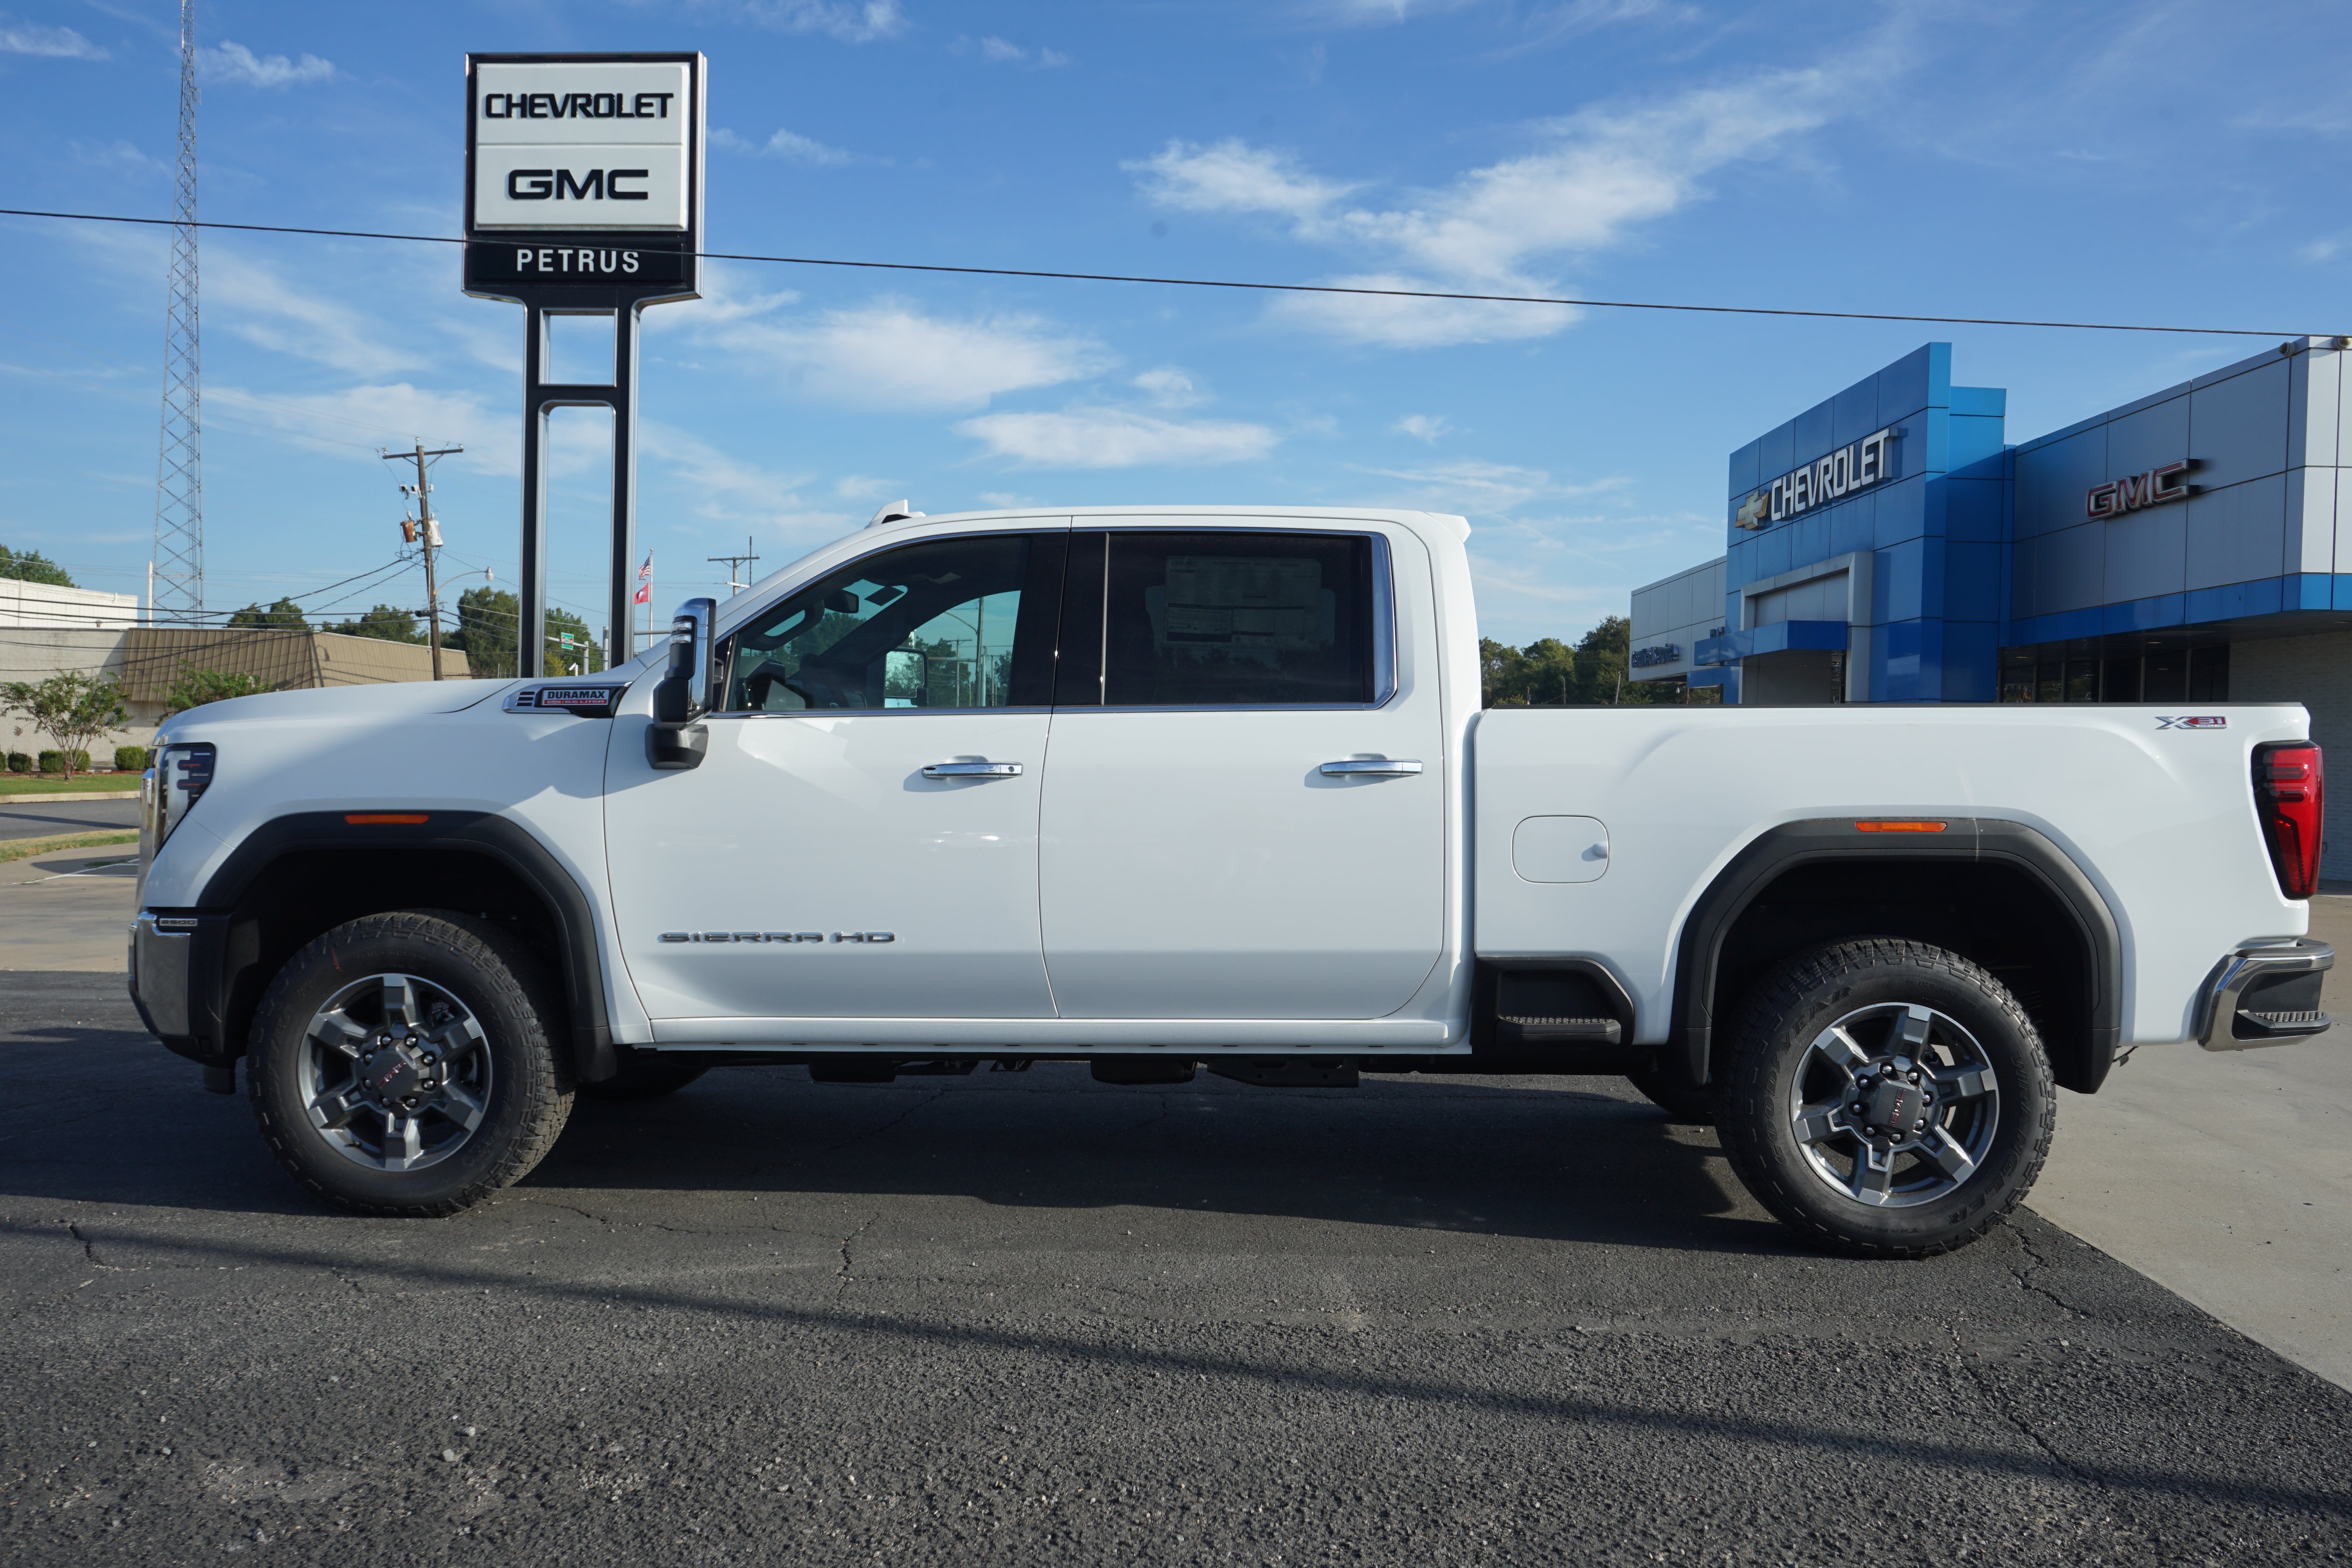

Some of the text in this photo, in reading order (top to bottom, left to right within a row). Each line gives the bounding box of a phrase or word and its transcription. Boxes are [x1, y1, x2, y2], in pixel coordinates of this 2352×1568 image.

[485, 93, 674, 118] CHEVROLET
[508, 169, 649, 200] GMC
[516, 249, 639, 273] PETRUS
[1771, 427, 1893, 522] CHEVROLET
[2085, 458, 2192, 521] GMC
[547, 691, 606, 699] DURAMAX
[662, 931, 895, 942] SIERRA HD
[376, 1060, 407, 1089] GMC
[1764, 986, 1852, 1166] GOODYEAR
[1889, 1087, 1906, 1125] GMC
[1947, 1051, 2031, 1225] WRANGLER
